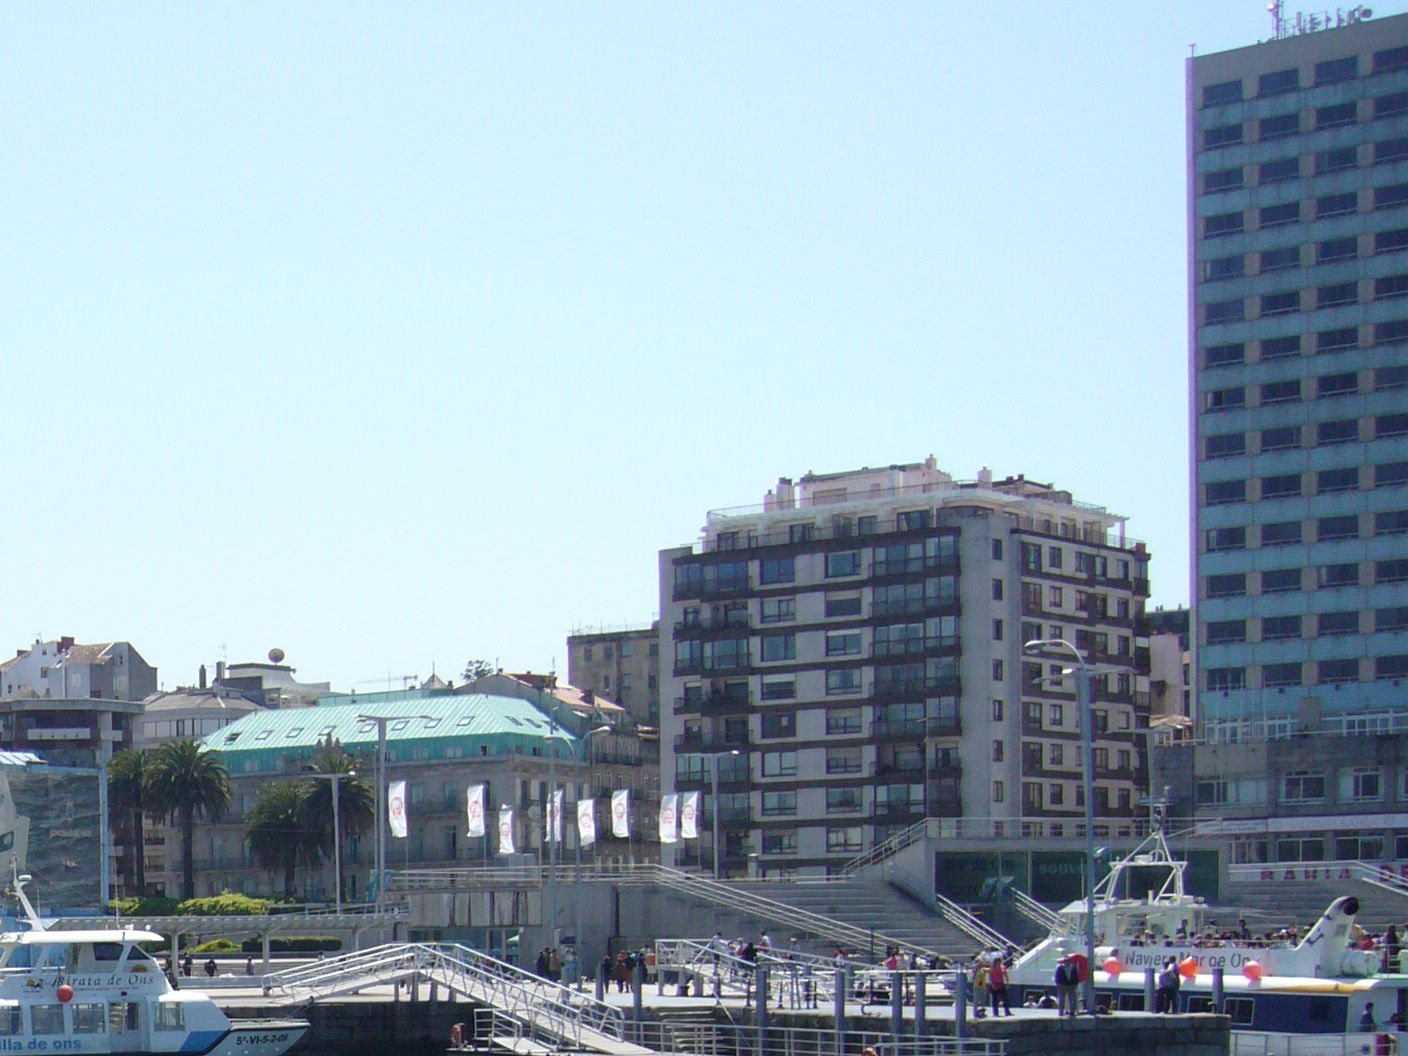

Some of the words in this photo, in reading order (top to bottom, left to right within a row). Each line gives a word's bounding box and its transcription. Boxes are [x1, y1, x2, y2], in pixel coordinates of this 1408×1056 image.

[1125, 950, 1173, 967] Navier
[1230, 952, 1252, 968] On
[108, 972, 122, 986] de
[128, 973, 154, 985] Ons
[28, 1037, 48, 1050] de
[52, 1039, 82, 1050] ons
